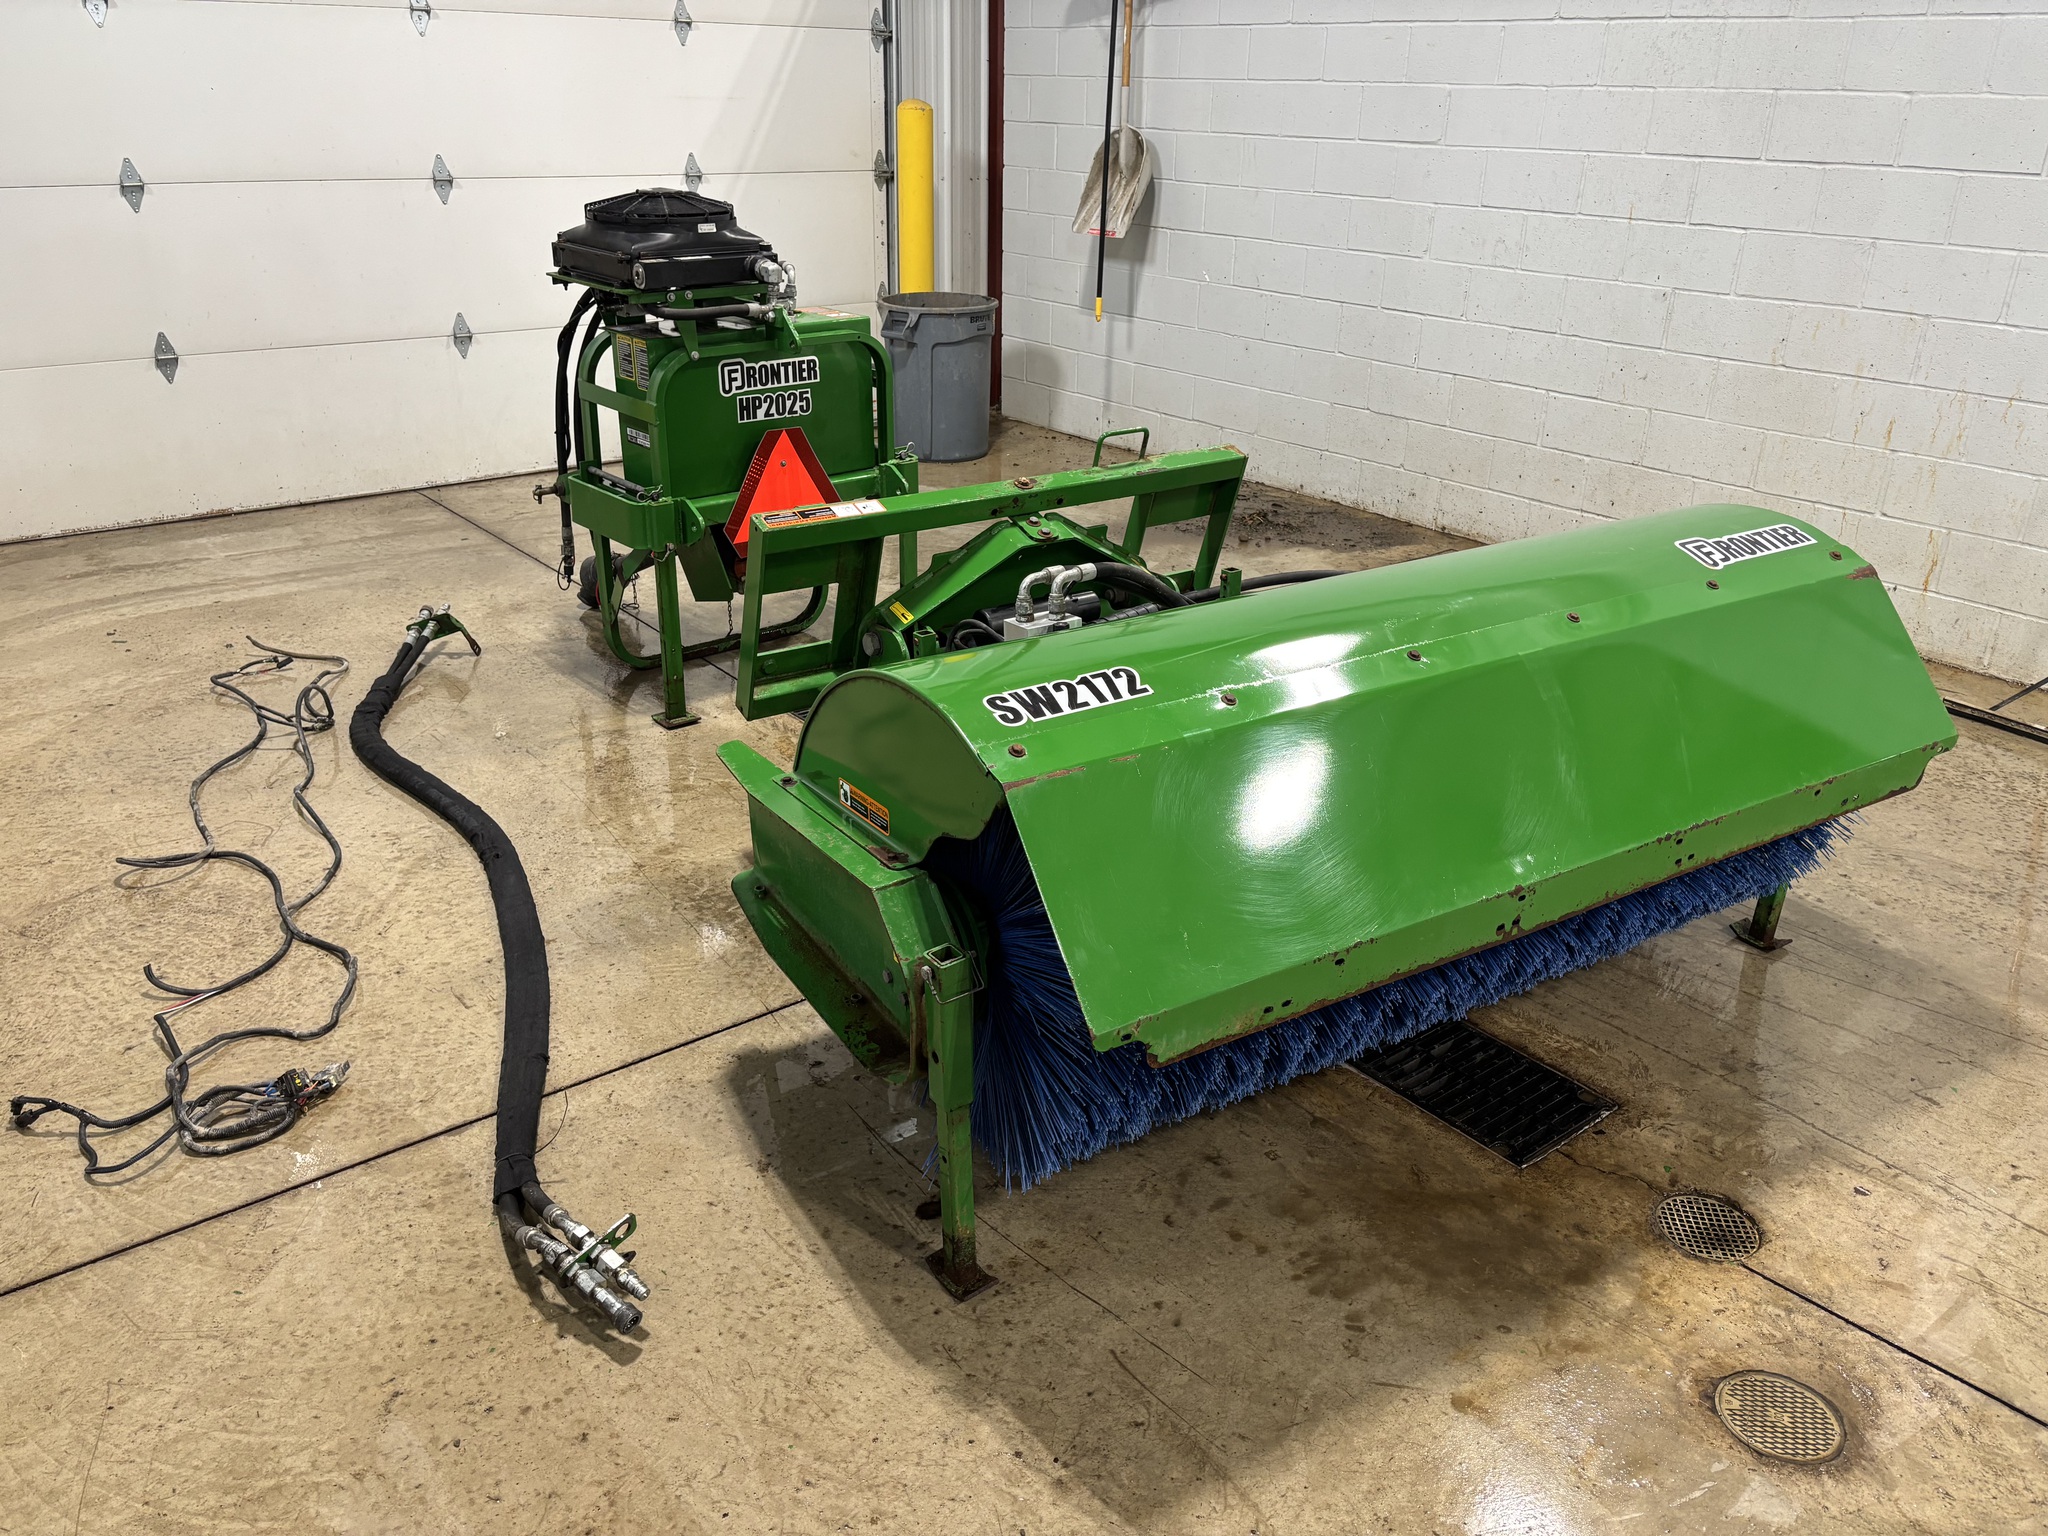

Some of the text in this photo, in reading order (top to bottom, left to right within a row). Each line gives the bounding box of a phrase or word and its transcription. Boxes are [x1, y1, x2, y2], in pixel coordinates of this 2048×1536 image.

[720, 359, 818, 395] FRONTIER
[738, 390, 811, 421] HP2025
[1679, 525, 1812, 567] FRONTIER
[986, 667, 1150, 724] SW2172
